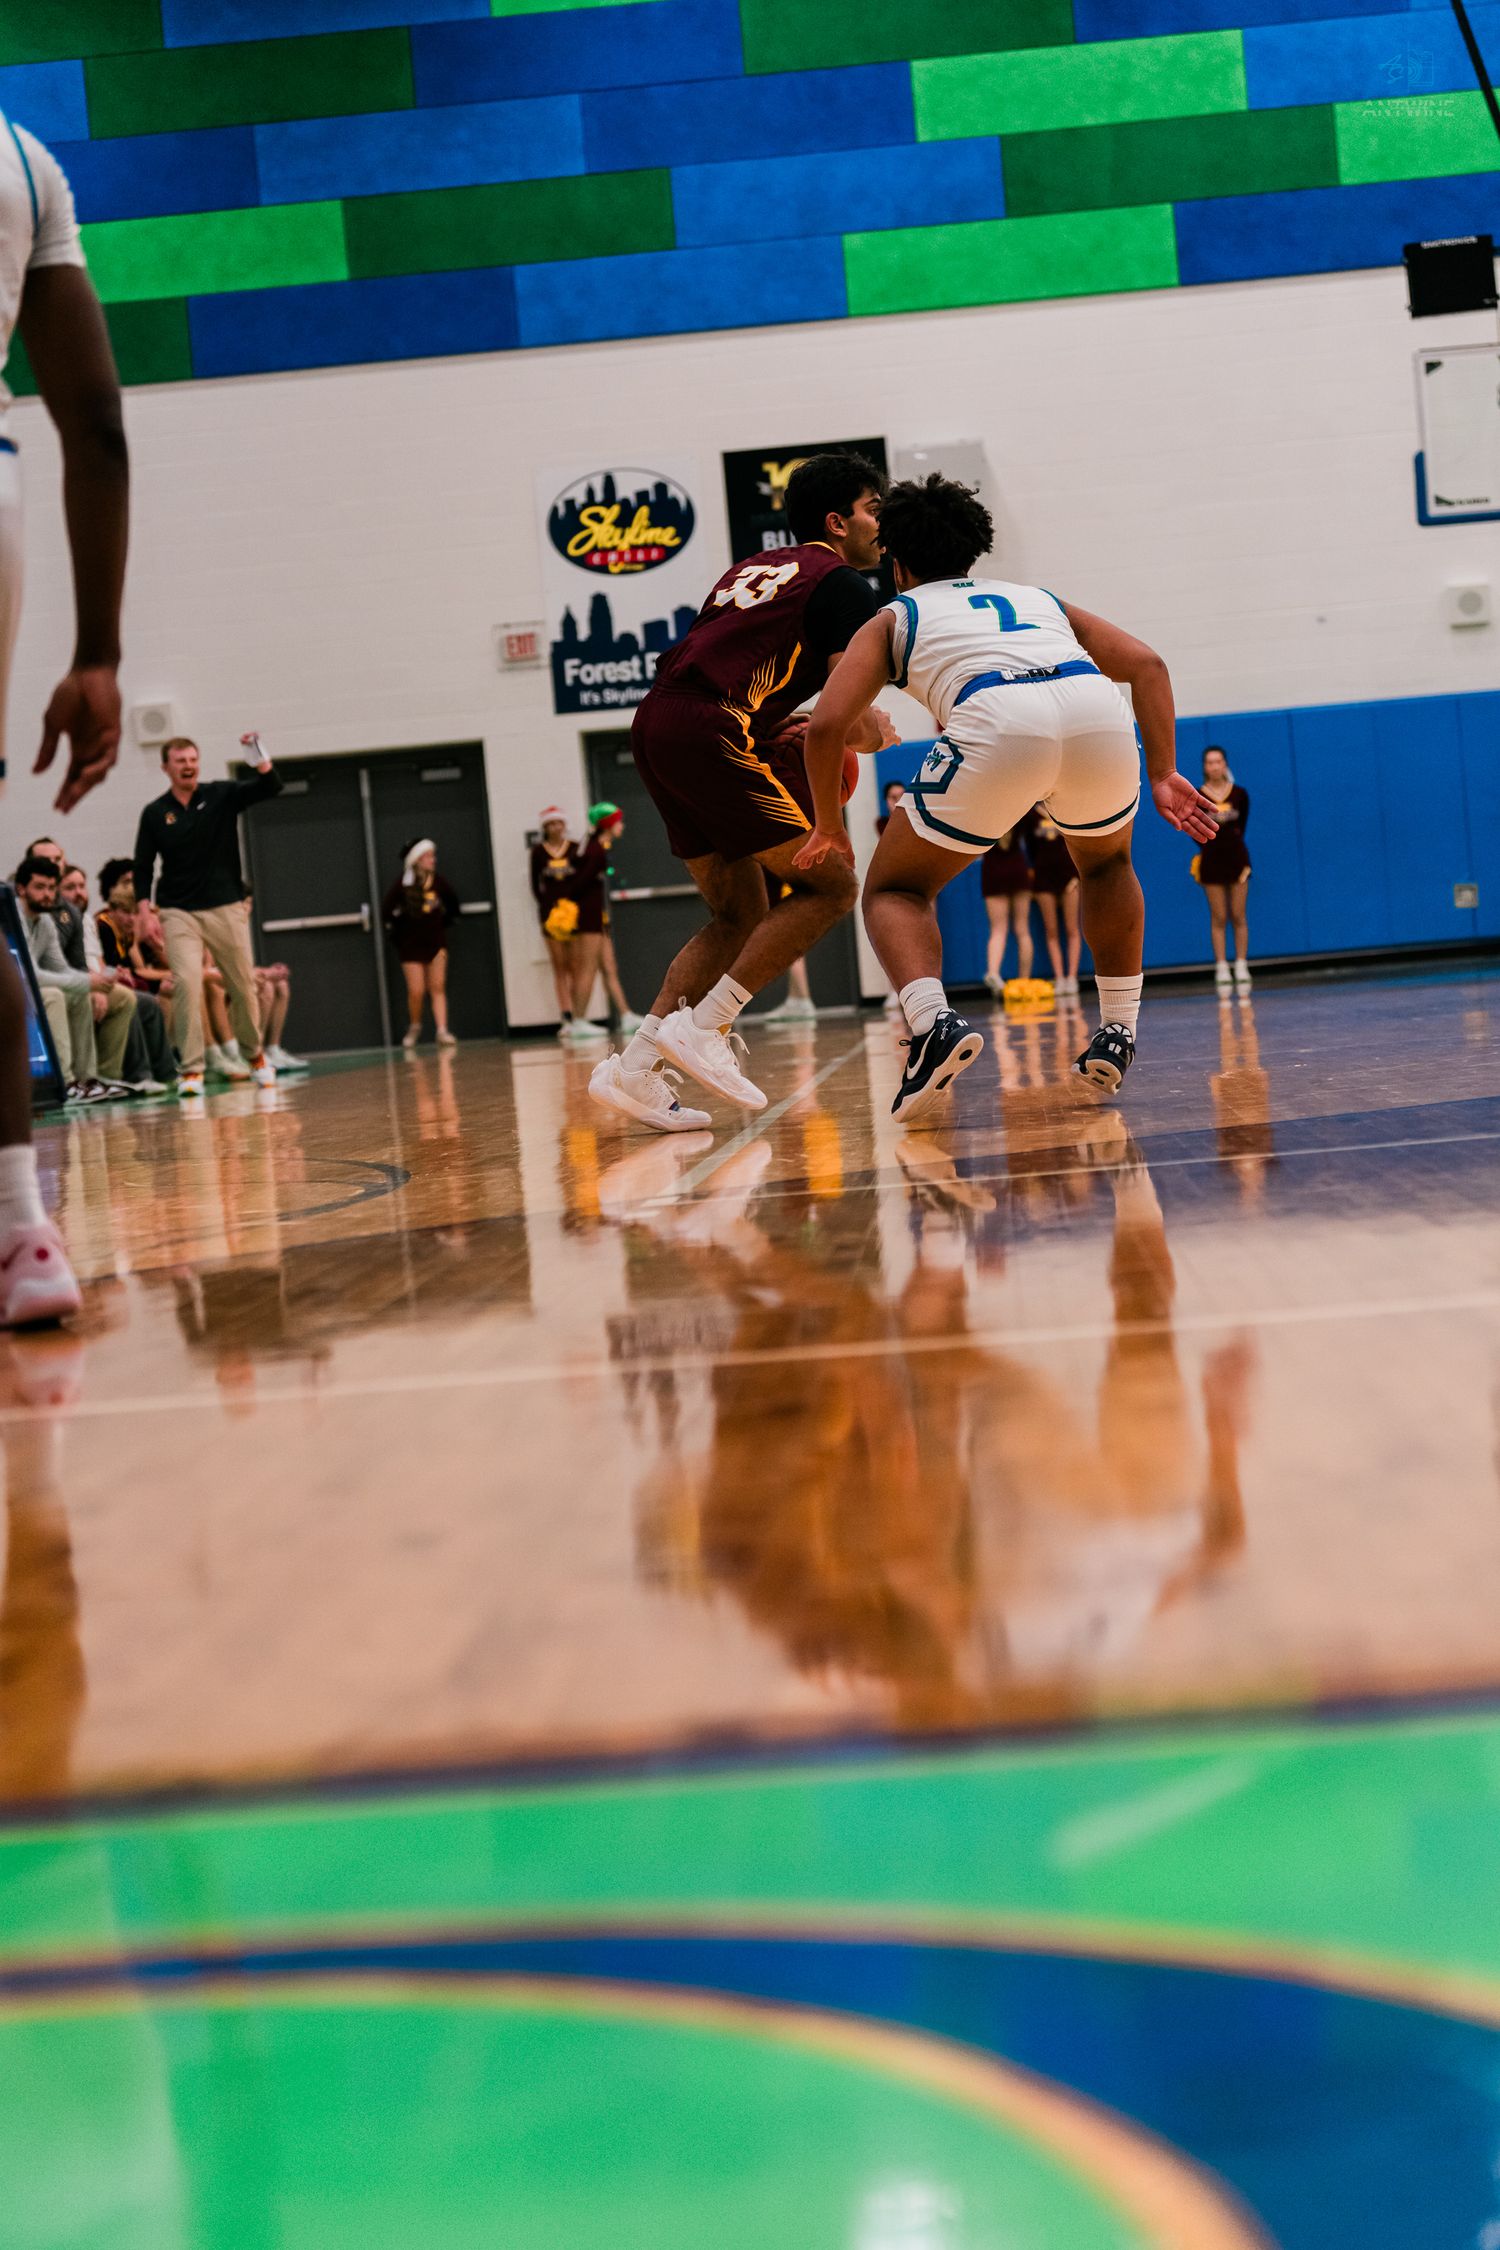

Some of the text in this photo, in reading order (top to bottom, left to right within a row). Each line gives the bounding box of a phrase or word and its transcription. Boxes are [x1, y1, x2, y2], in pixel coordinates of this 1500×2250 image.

[567, 503, 681, 557] Skyline
[713, 561, 800, 610] 33
[967, 594, 1041, 632] 2
[506, 632, 537, 658] EXIT
[563, 655, 643, 686] Forest
